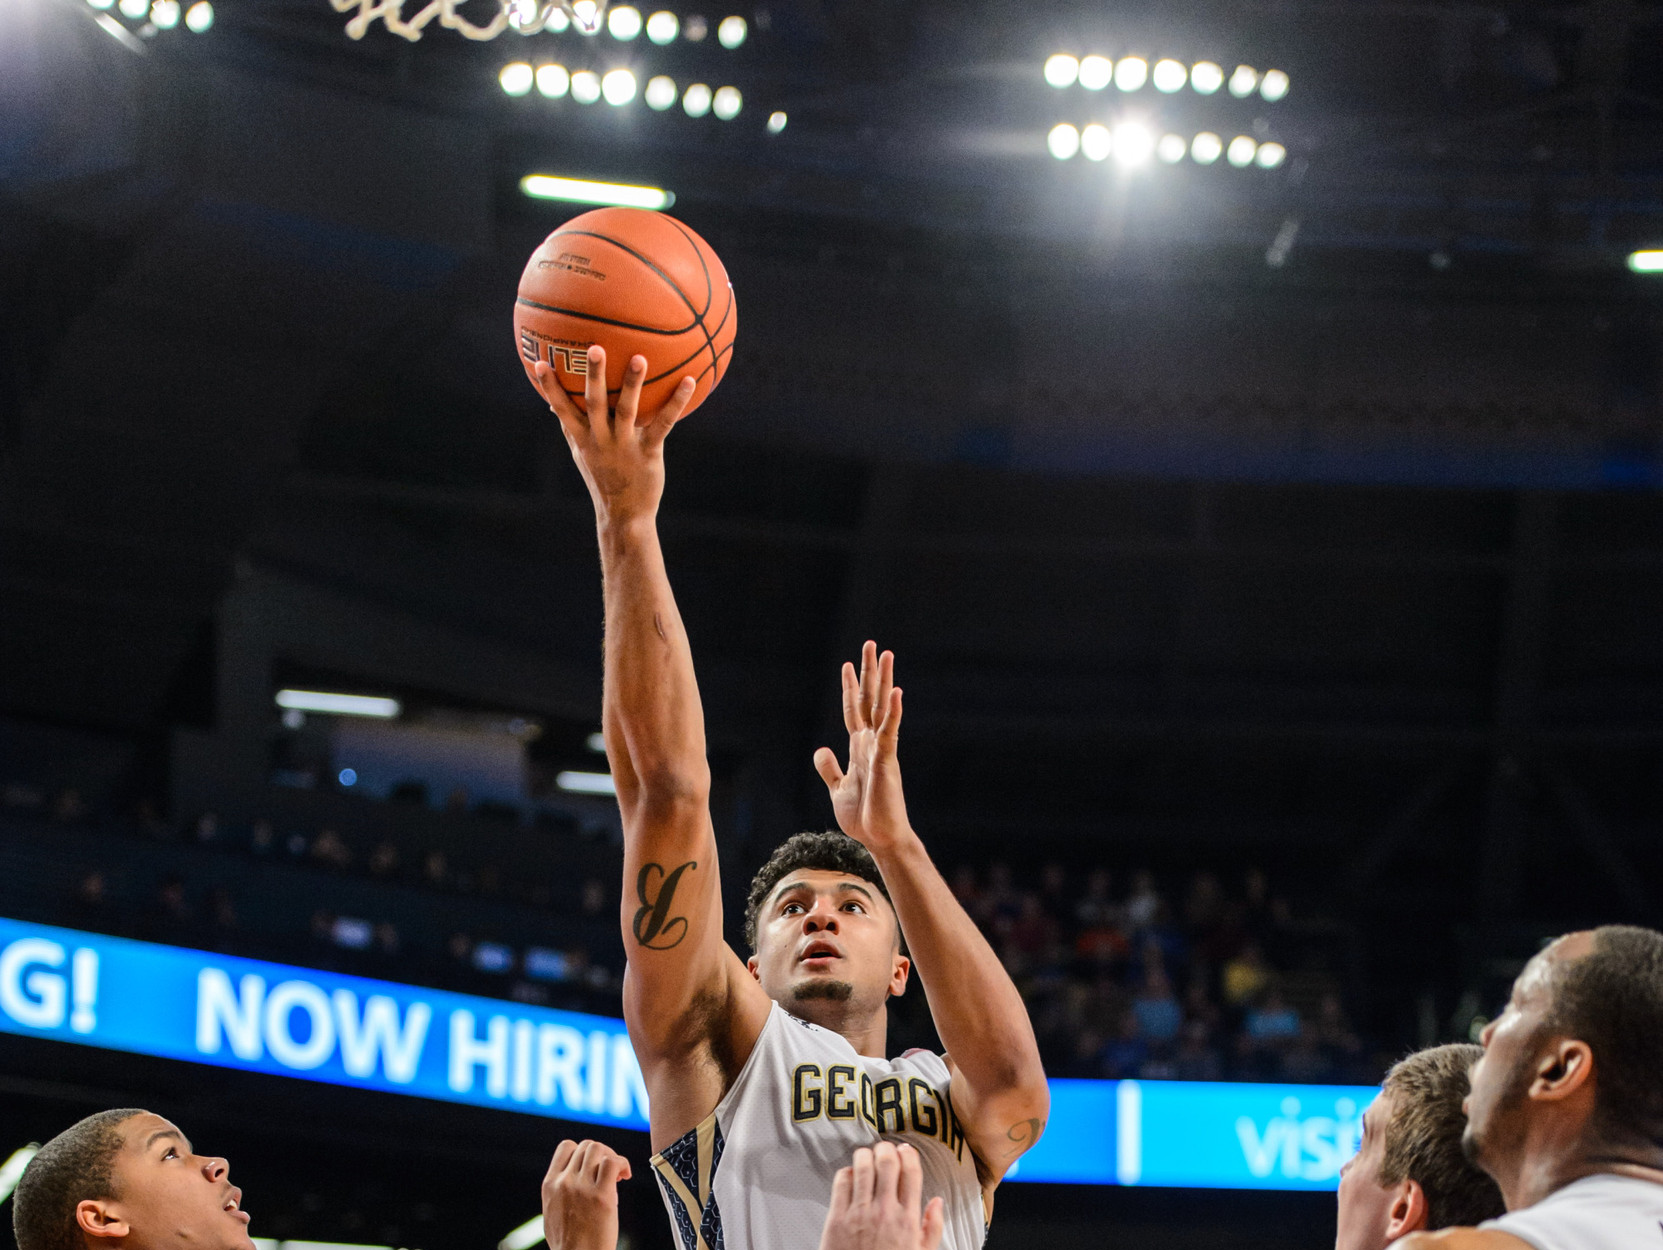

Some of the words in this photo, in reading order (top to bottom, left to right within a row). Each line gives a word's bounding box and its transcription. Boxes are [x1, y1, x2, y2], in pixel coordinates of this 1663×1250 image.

[195, 966, 432, 1084] NOW
[449, 1008, 651, 1122] HIRIN
[1234, 1095, 1365, 1182] visi
